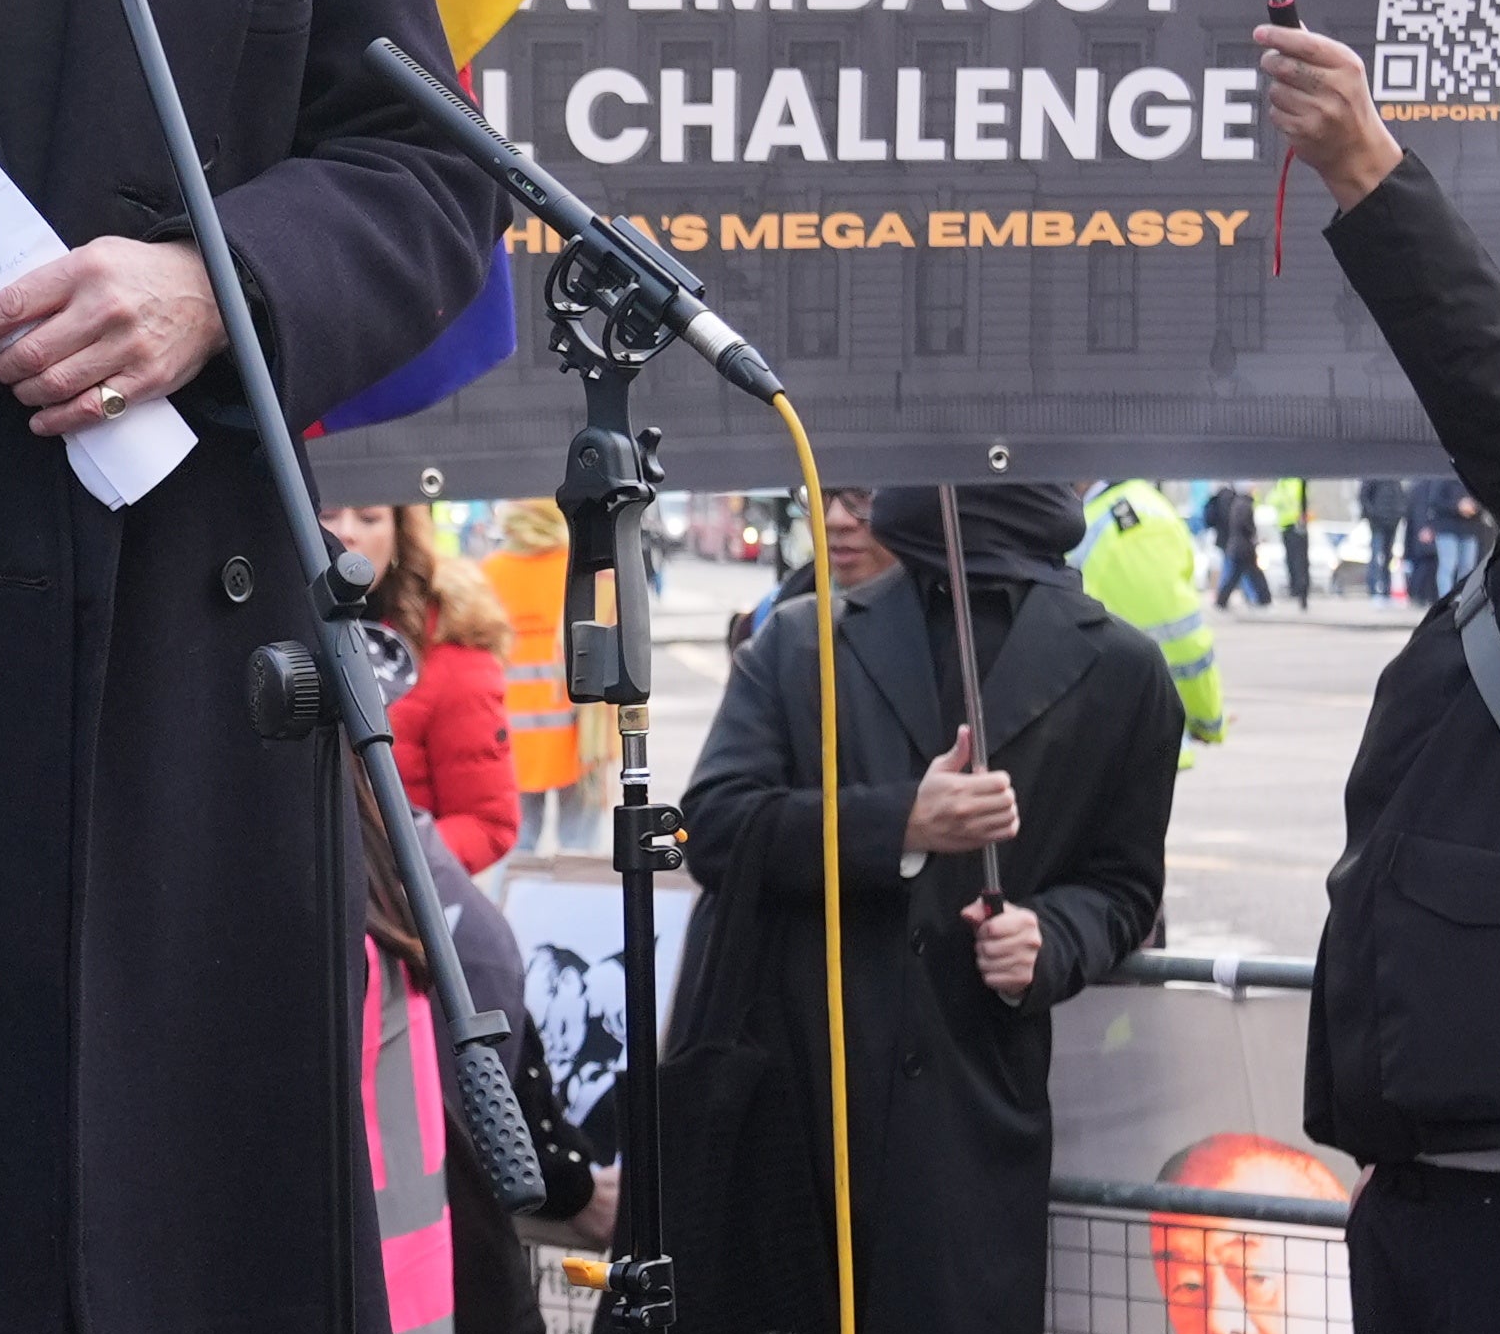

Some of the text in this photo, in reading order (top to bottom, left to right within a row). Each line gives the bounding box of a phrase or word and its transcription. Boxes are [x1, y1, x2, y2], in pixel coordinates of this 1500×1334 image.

[565, 66, 1258, 165] CHALLENGE
[1380, 103, 1500, 122] SUPPORT
[720, 212, 916, 250] MEGA
[928, 209, 1250, 248] EMBASSY
